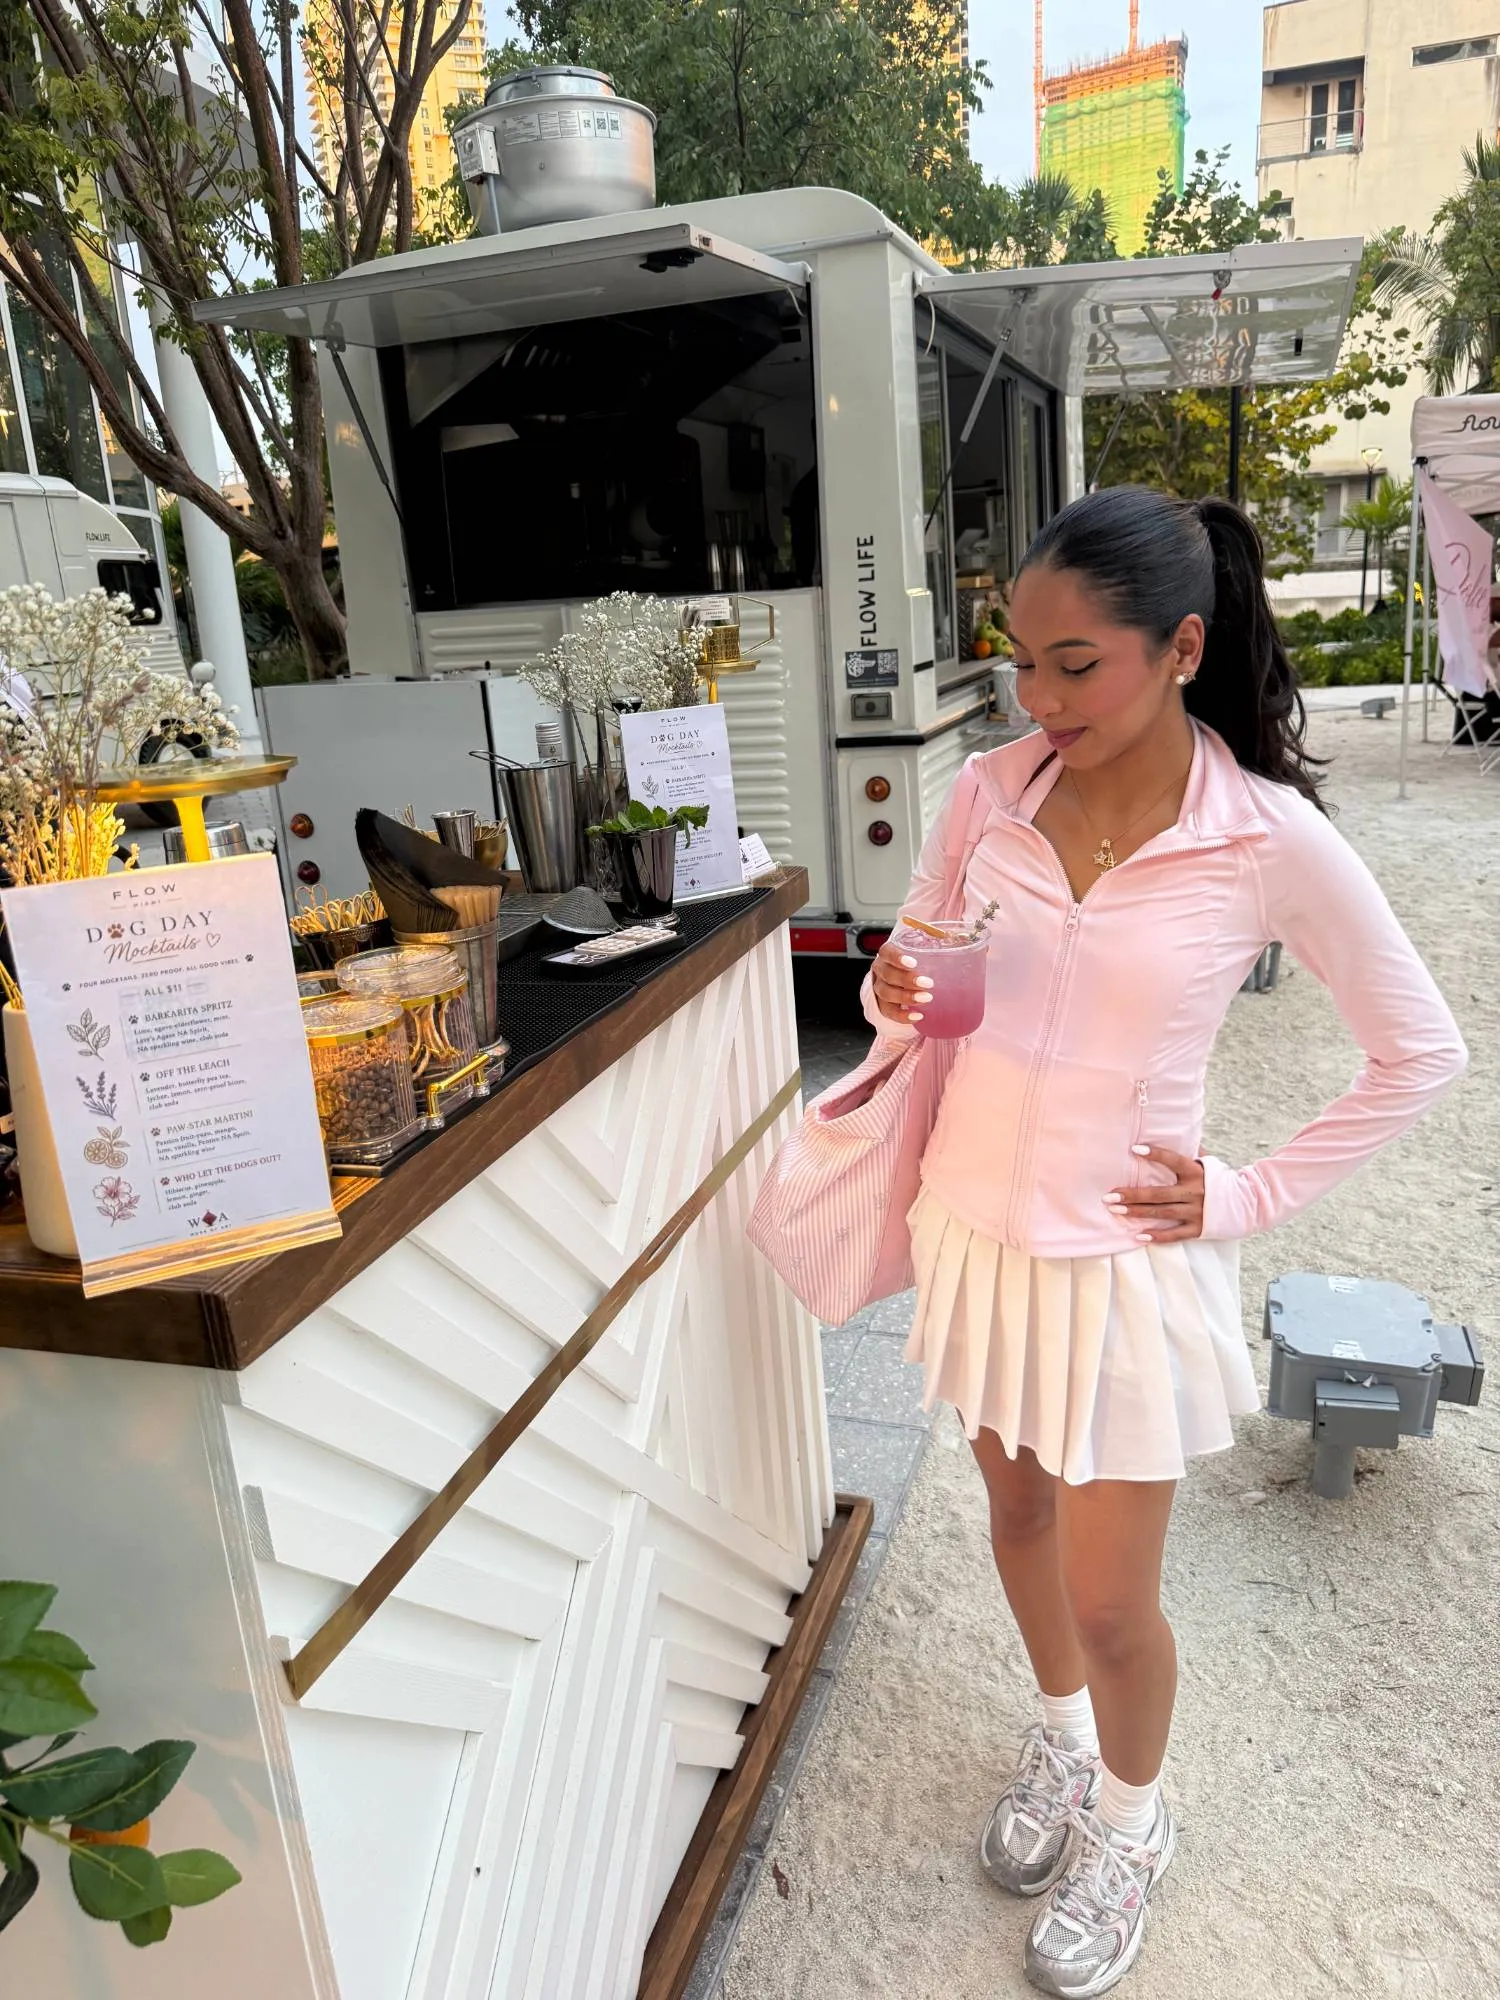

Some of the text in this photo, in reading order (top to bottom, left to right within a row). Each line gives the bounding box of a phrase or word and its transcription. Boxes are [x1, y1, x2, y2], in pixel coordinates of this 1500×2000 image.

[857, 535, 877, 647] FLOW LIFE
[679, 729, 701, 740] DAY
[113, 884, 176, 900] FLOW
[161, 910, 214, 931] DAY
[103, 932, 201, 964] Mocktails
[199, 961, 218, 969] GOOD
[144, 987, 163, 996] ALL
[145, 1000, 232, 1021] BARKARITA SPRITZ
[156, 1059, 230, 1079] OFF THE LEACH
[166, 1110, 253, 1133] PAW-STAR MARTINI
[174, 1154, 281, 1182] WHO LET THE DOGS OUT?
